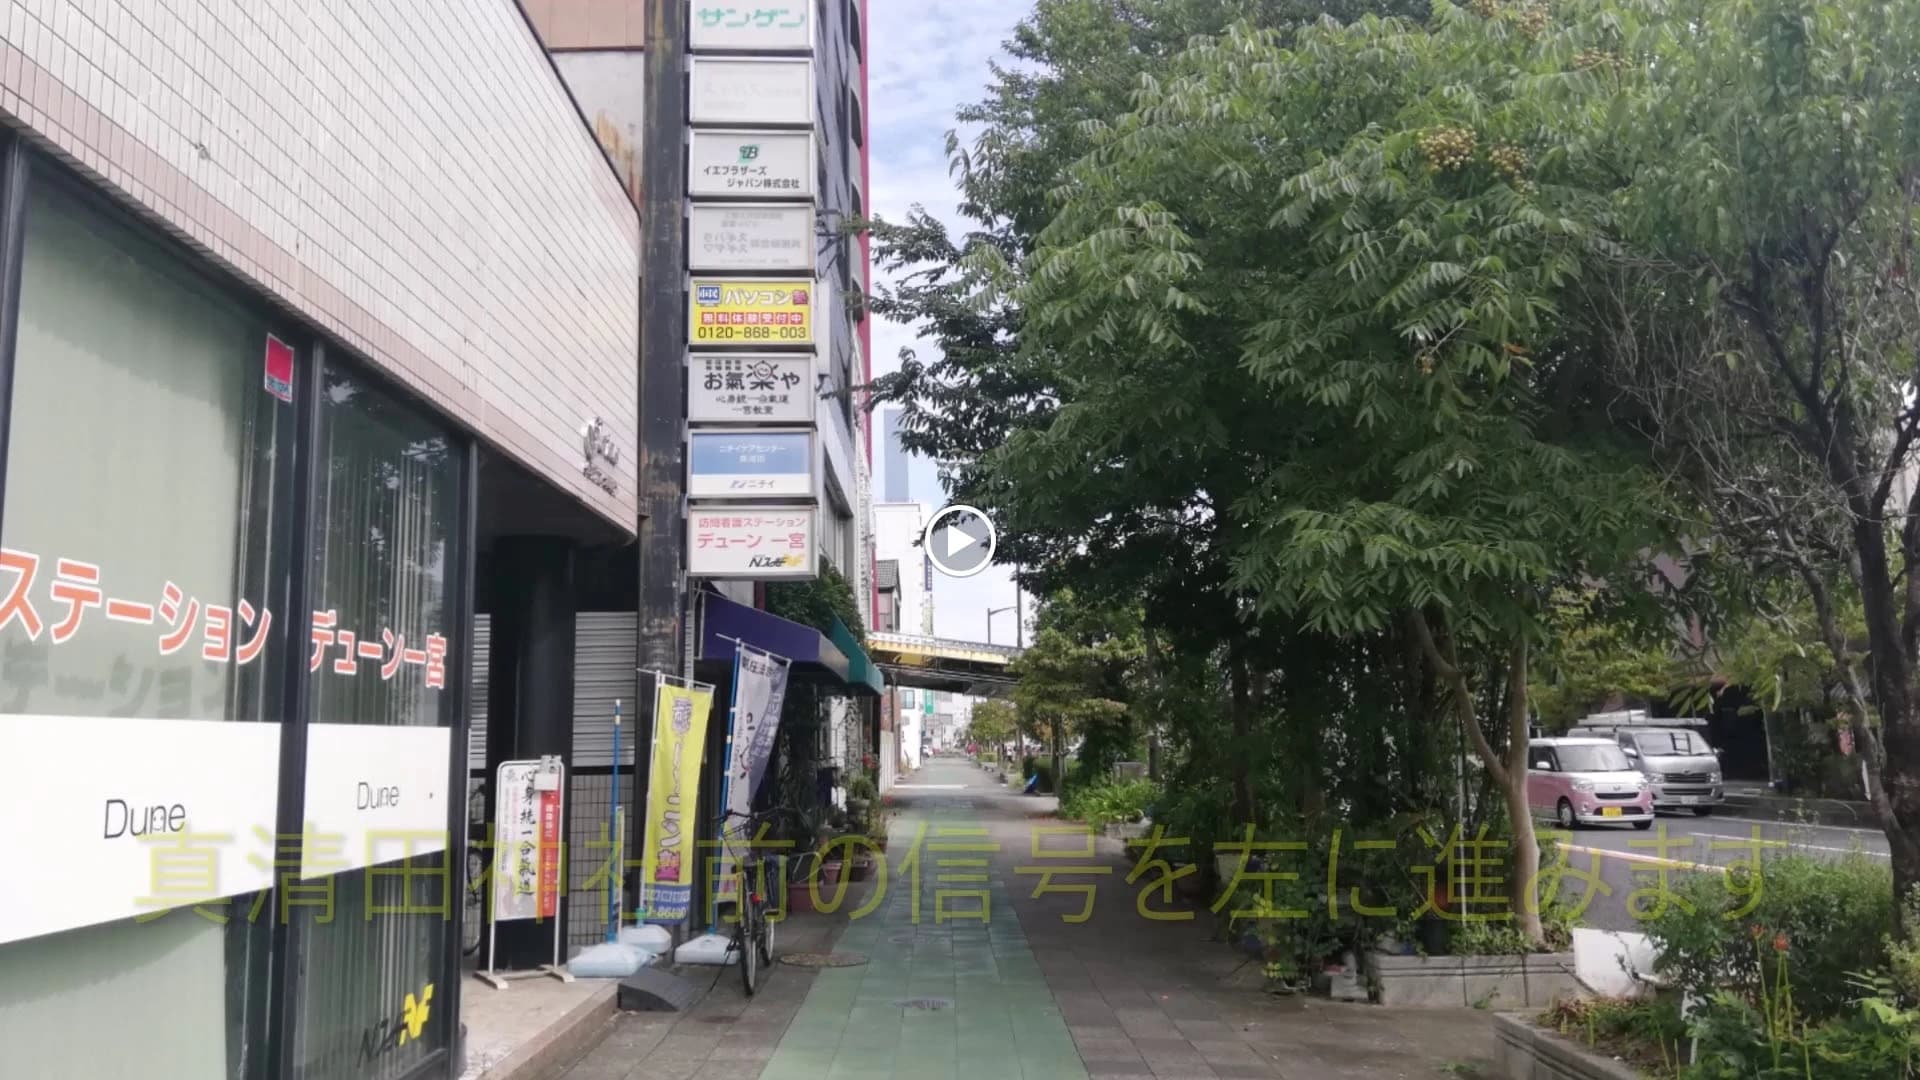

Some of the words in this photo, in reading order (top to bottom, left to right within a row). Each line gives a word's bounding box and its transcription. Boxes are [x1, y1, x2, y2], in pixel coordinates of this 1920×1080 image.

[727, 178, 800, 189] ジャパン株式会社
[697, 326, 807, 339] 0120-868-003
[697, 517, 806, 529] 訪問看護ステーション
[697, 532, 763, 549] デューン
[0, 547, 272, 665] ステーション
[356, 781, 400, 810] Dune
[104, 799, 186, 839] Dune
